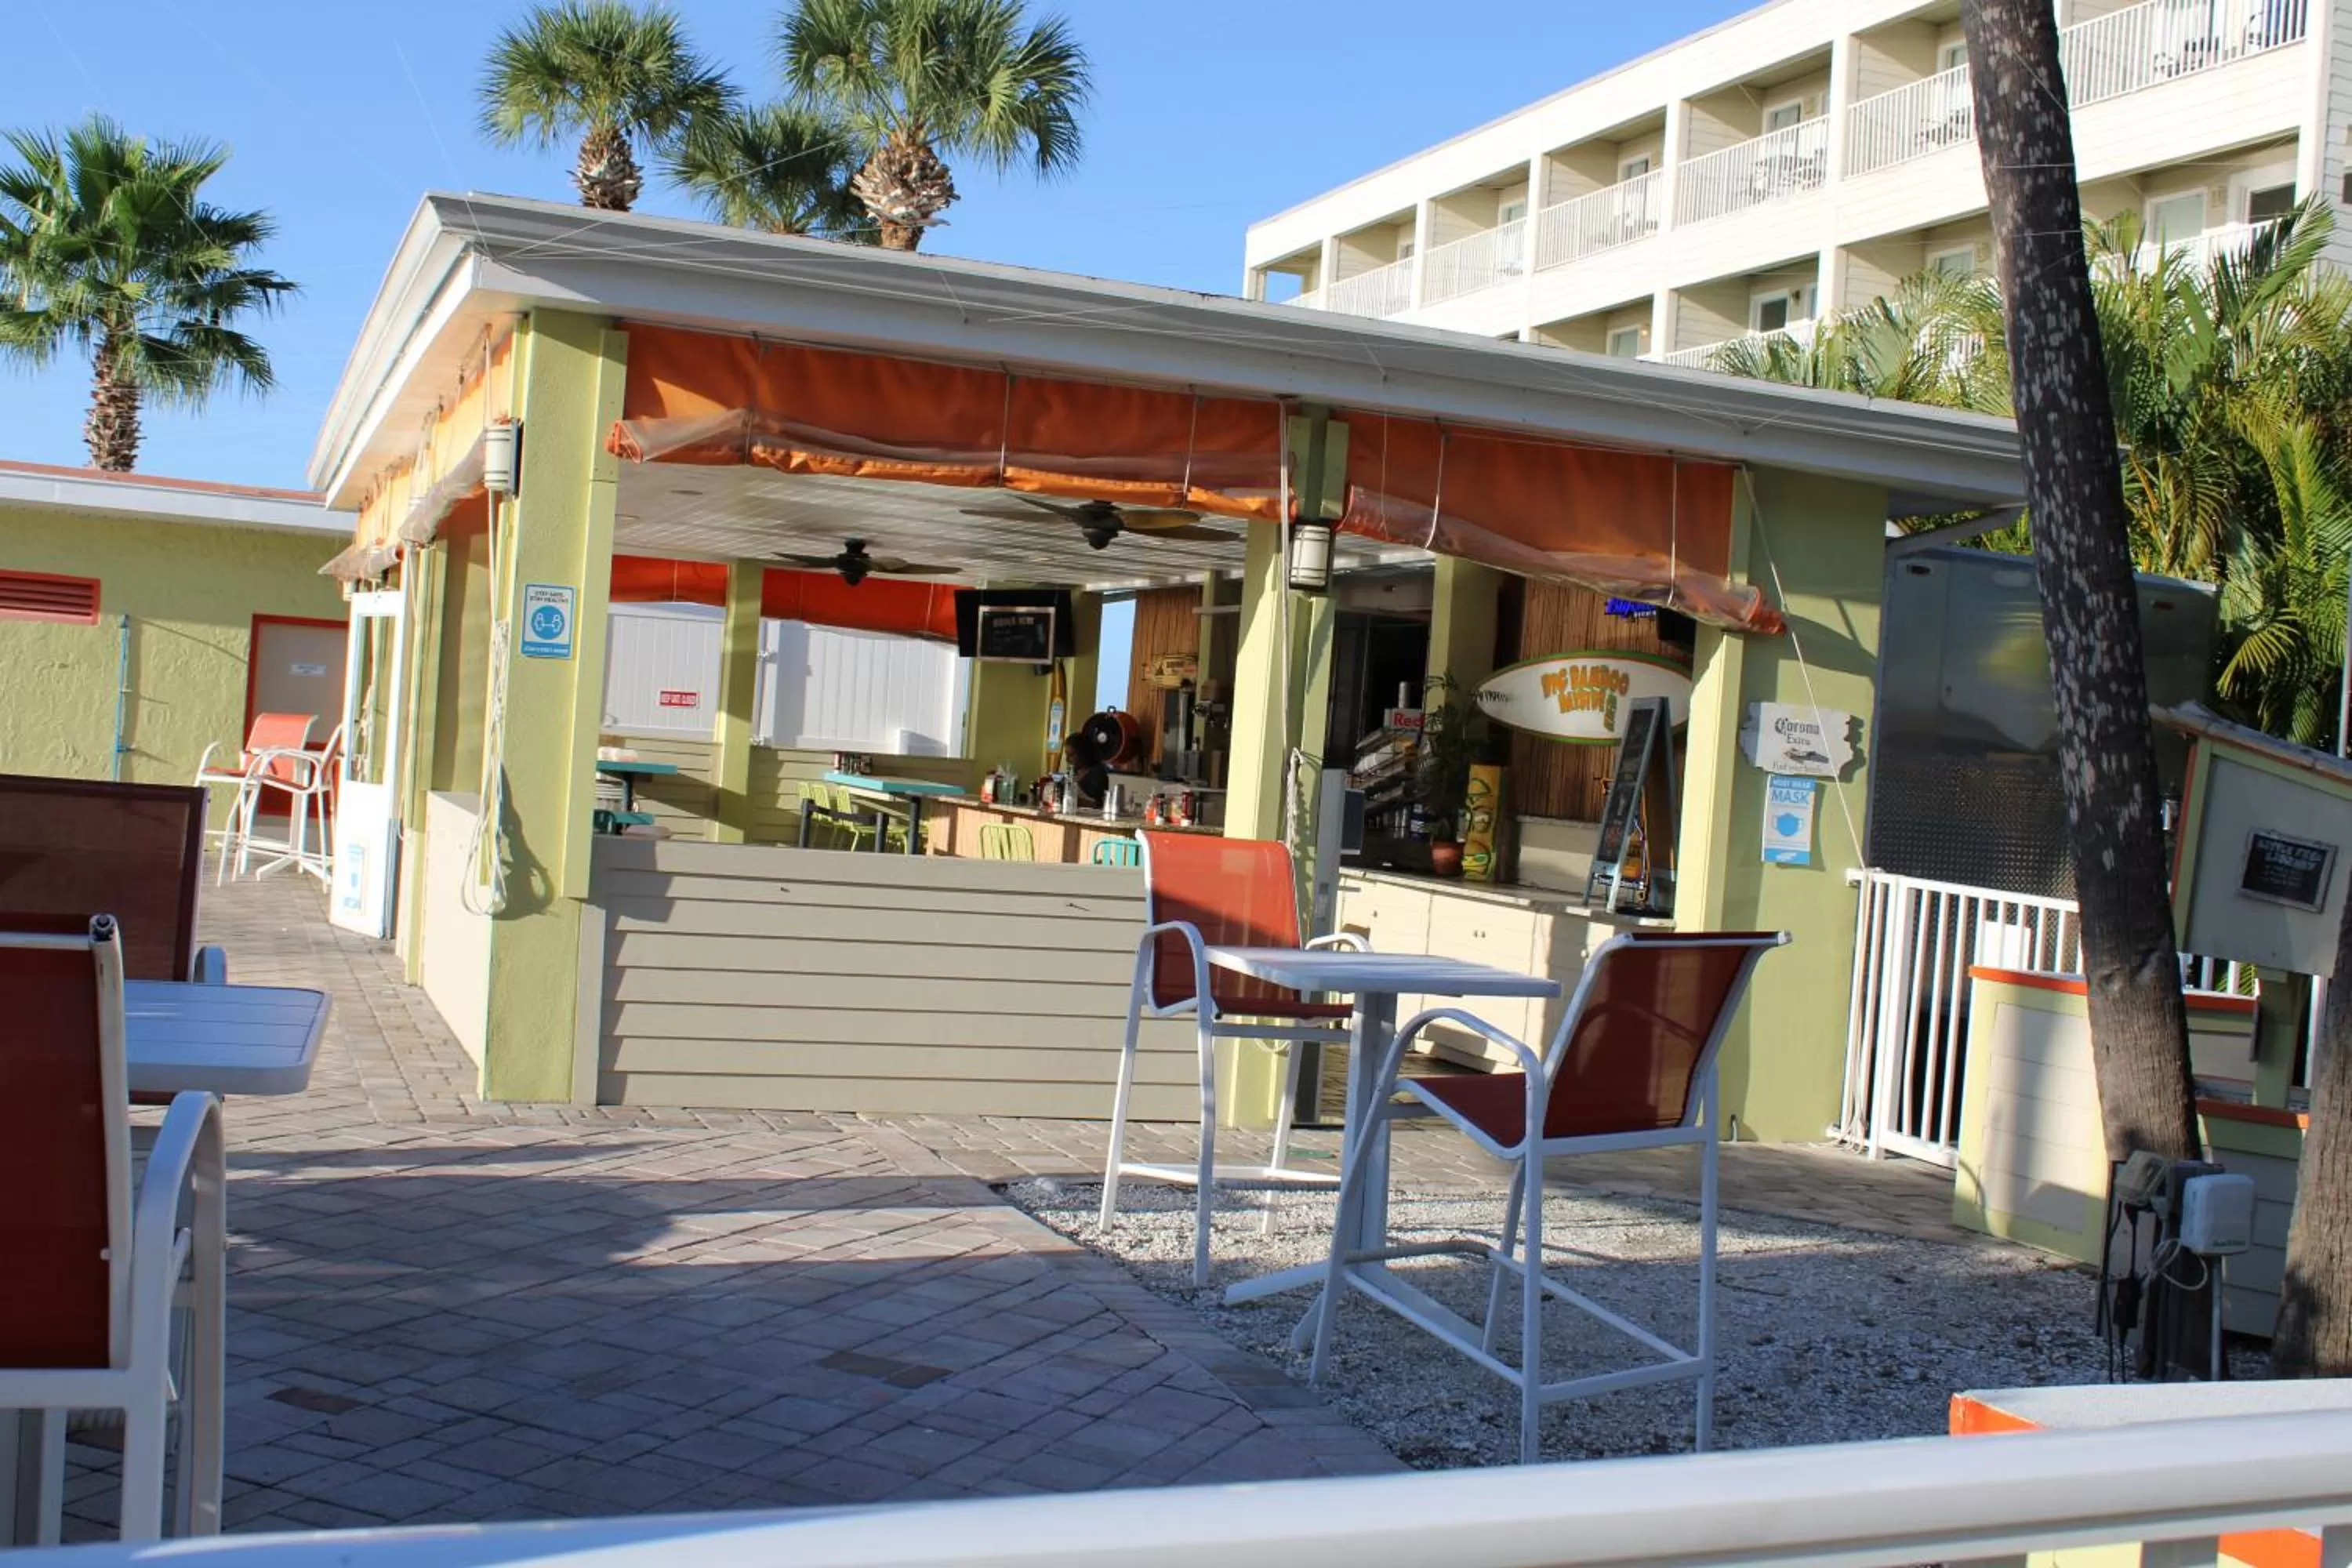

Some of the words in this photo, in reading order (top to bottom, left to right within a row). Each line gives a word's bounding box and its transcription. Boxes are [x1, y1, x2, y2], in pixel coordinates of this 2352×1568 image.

[1394, 712, 1425, 727] Red
[1774, 717, 1820, 736] Corona
[1787, 734, 1811, 746] Extra
[1771, 789, 1809, 804] MASK
